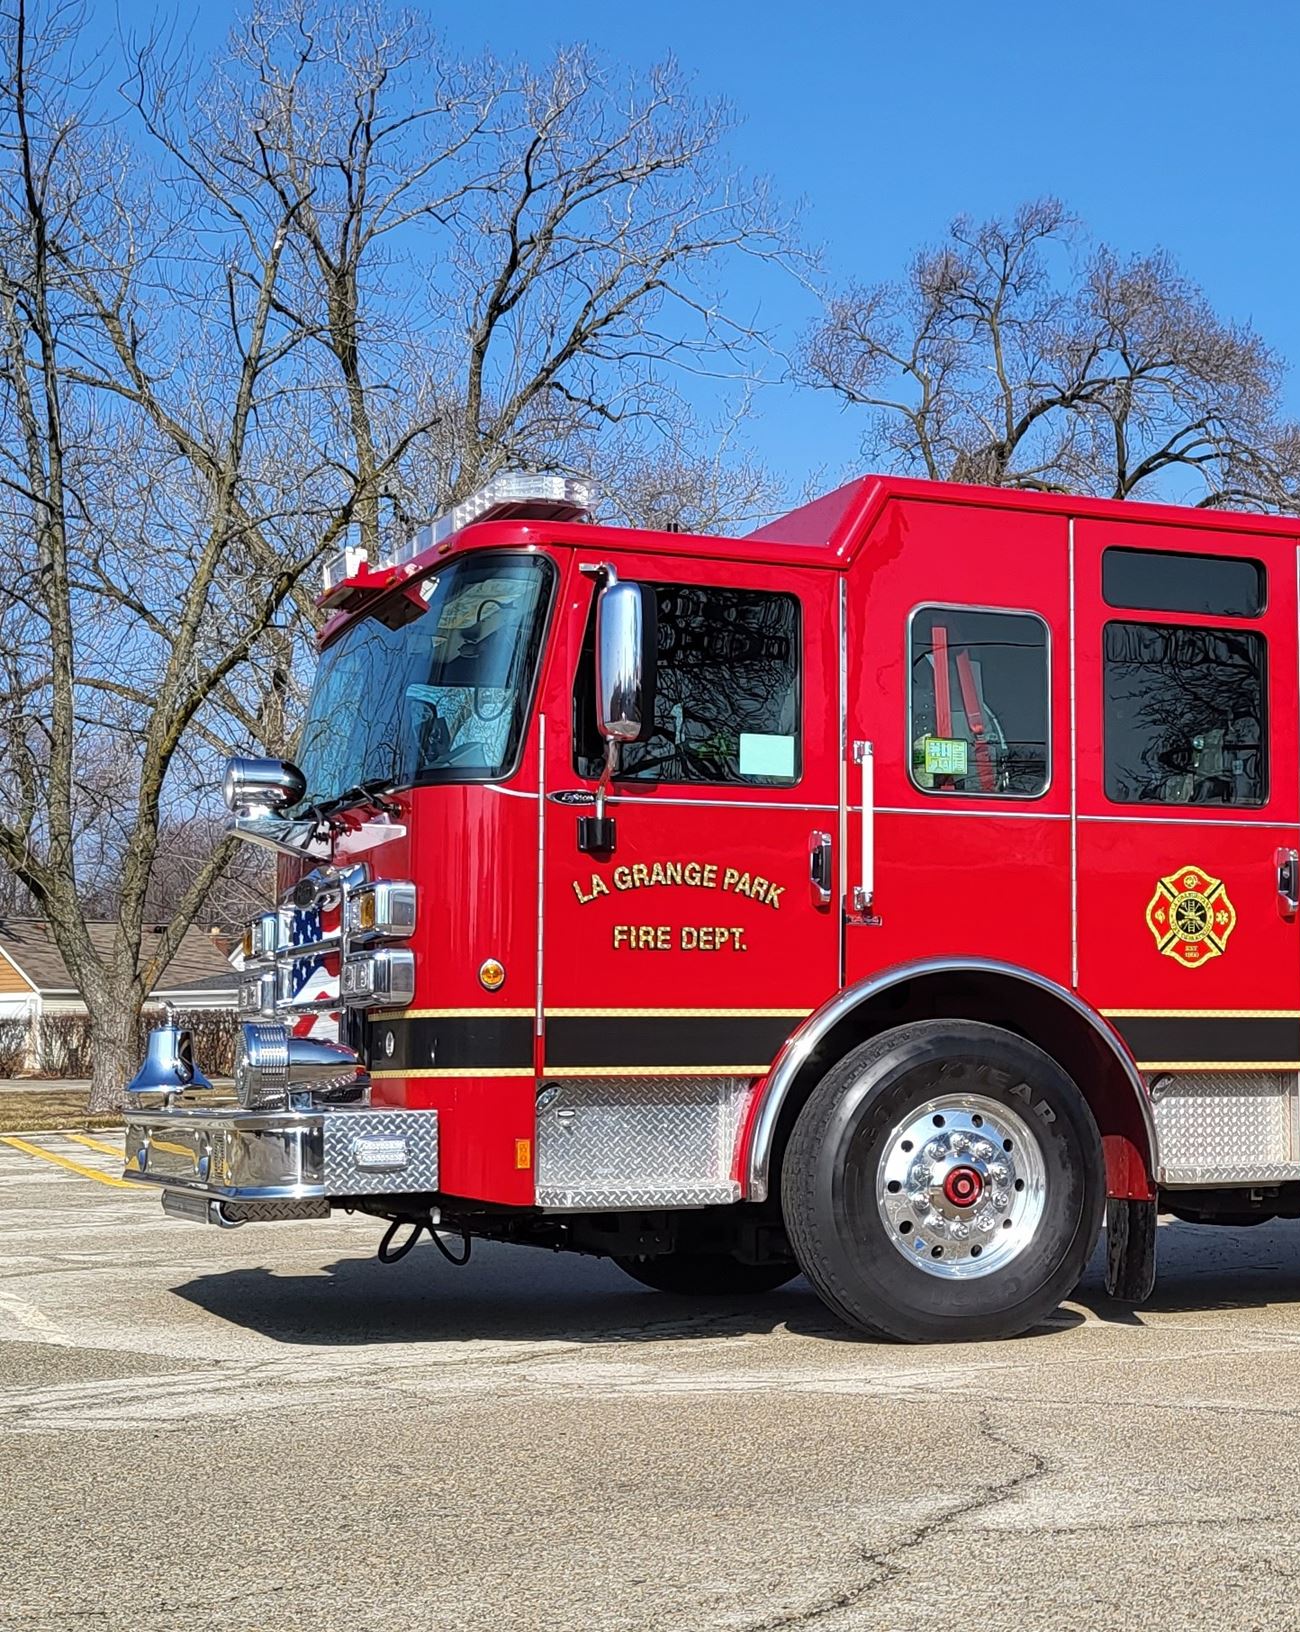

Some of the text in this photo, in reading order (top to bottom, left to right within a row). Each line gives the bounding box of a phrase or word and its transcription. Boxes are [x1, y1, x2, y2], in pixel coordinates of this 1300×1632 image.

[572, 861, 786, 909] LA GRANGE PARK
[613, 925, 748, 951] FIRE DEPT.
